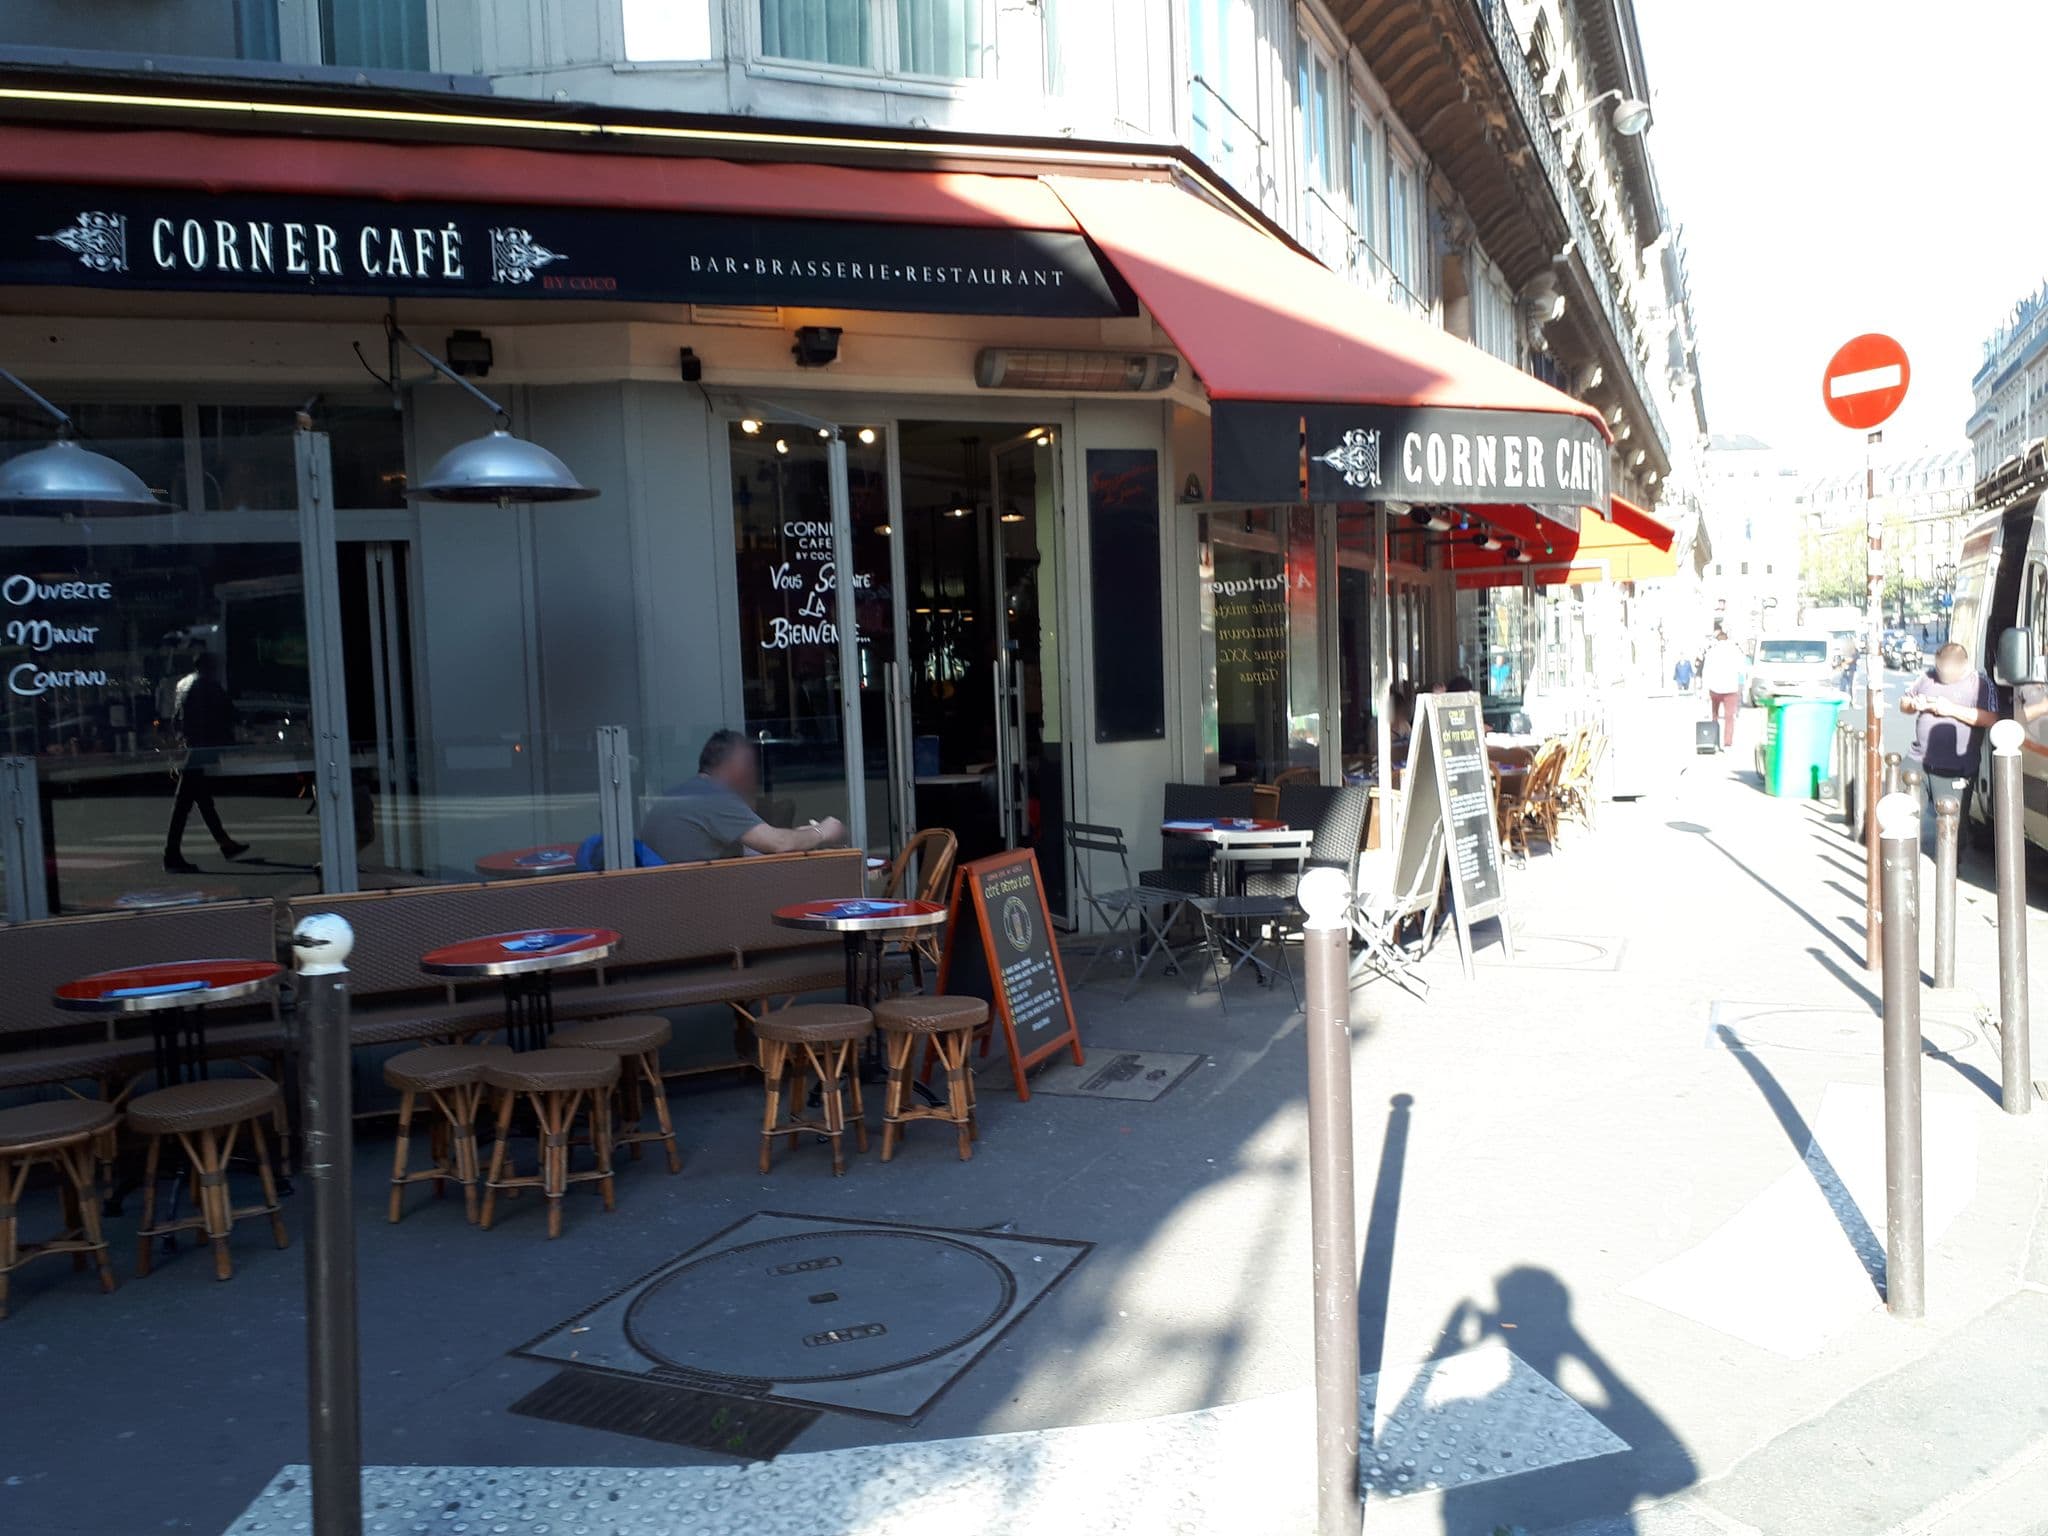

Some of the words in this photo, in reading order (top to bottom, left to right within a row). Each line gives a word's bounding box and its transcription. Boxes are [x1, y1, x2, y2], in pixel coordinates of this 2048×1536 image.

[152, 217, 343, 275] CORNER
[360, 221, 464, 280] CAFÉ
[689, 255, 737, 274] BAR
[754, 258, 889, 281] BRASSERIE
[906, 264, 1064, 287] RESTAURANT
[1402, 431, 1546, 489] CORNER
